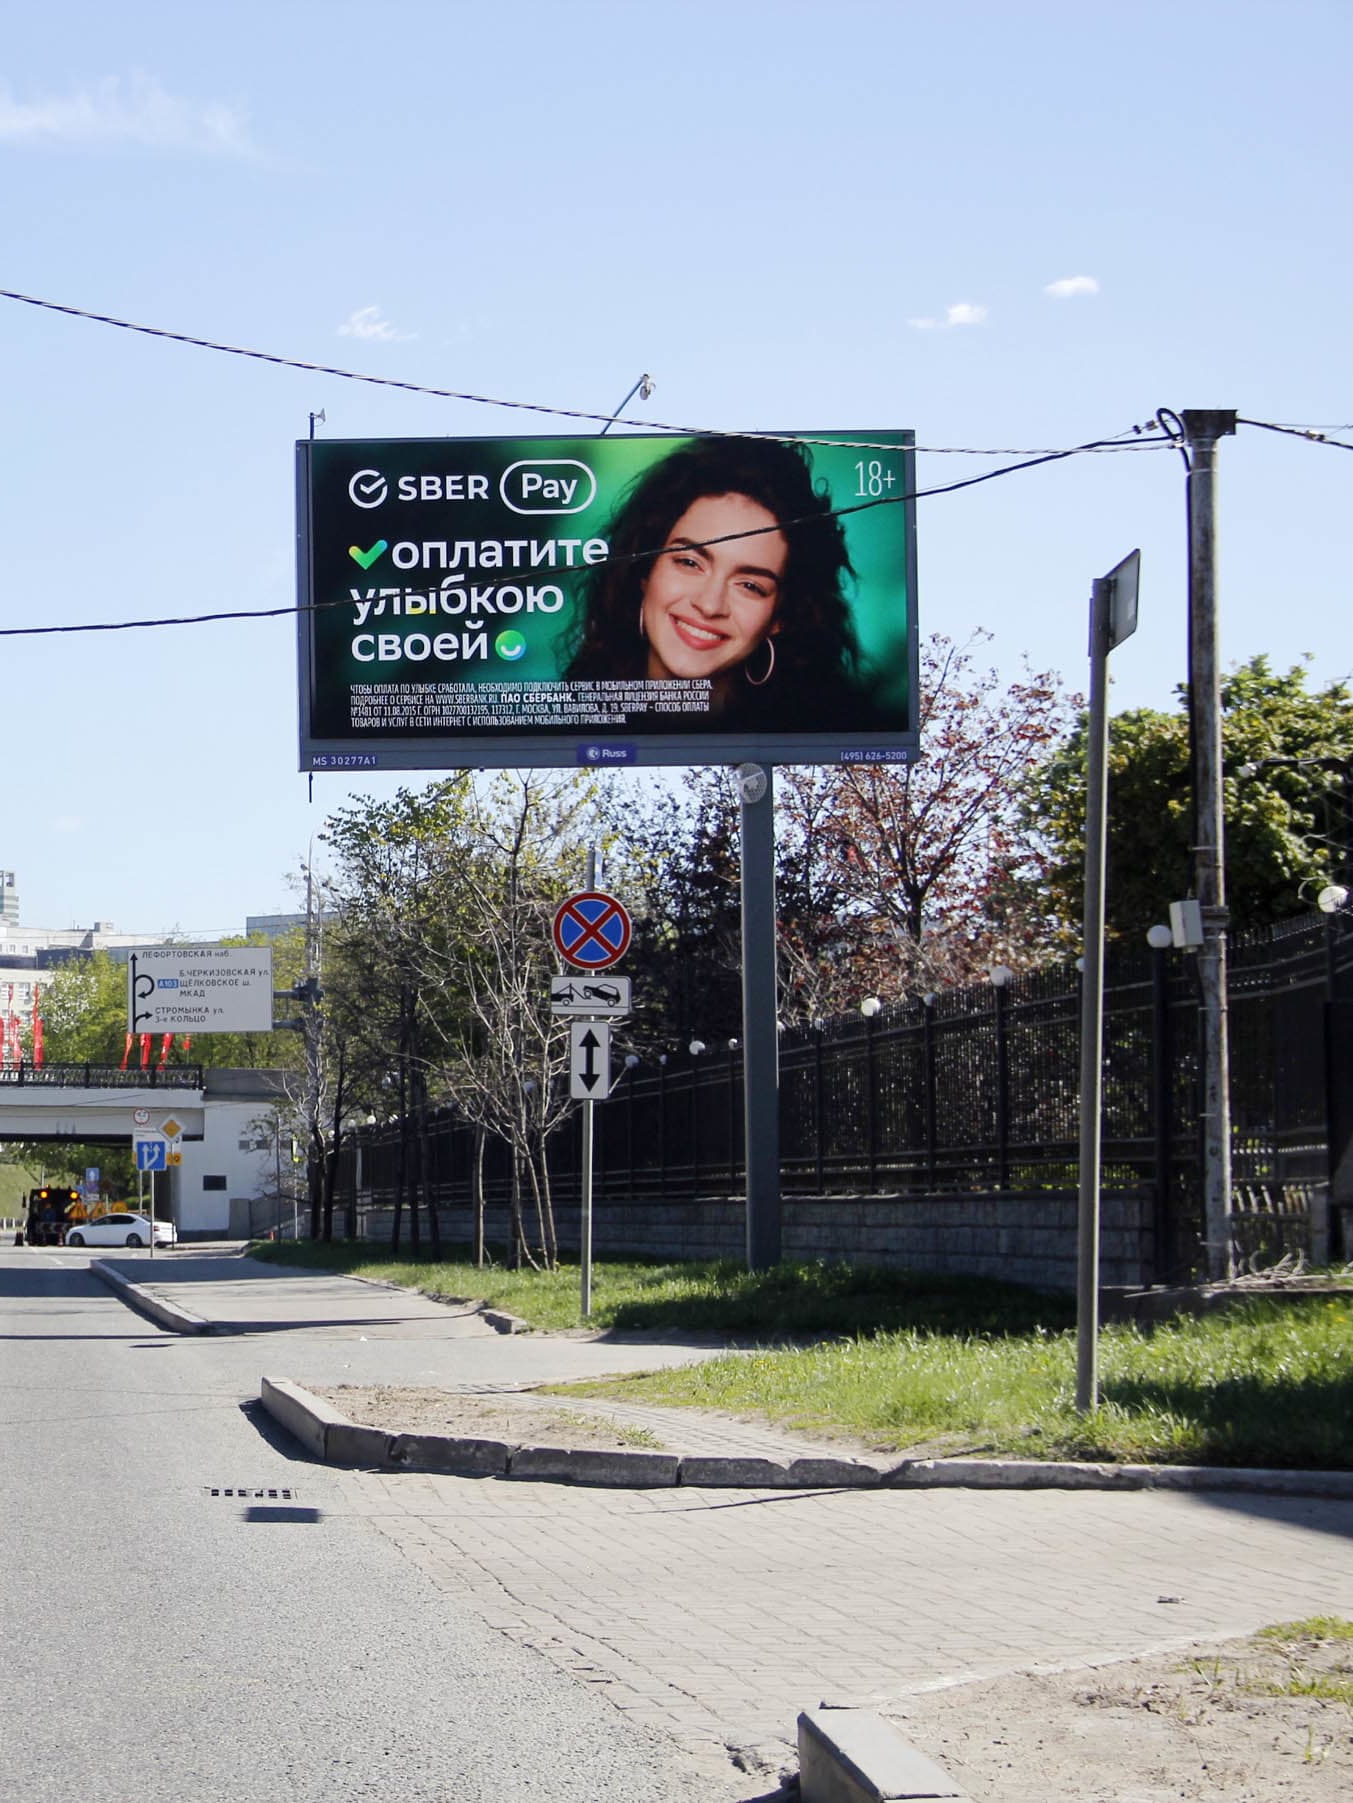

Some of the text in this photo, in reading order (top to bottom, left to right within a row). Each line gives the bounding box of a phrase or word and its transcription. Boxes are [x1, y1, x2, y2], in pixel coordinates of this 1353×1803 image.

[855, 460, 896, 497] 18+
[398, 472, 578, 505] SBER Pay
[391, 537, 609, 570] оплатите
[350, 573, 564, 626] улыбкою
[351, 620, 488, 662] своей
[350, 684, 372, 694] ЧТОБЫ
[374, 684, 399, 694] ОПЛАТА
[400, 683, 410, 694] ПО
[411, 683, 437, 693] УЛЫБКЕ
[437, 683, 477, 693] СРАБОТАЛА,
[478, 682, 523, 693] НЕОБХОДИМО
[524, 682, 569, 692] ПОДКЛЮЧИТЬ
[570, 681, 595, 692] СЕРВИС
[596, 681, 600, 691] В
[601, 681, 644, 691] МОБИЛЬНОМ
[645, 680, 690, 691] ПРИЛОЖЕНИИ
[350, 695, 389, 705] ПОДРОБНЕЕ
[389, 695, 395, 705] О
[396, 695, 424, 705] СЕРВИСЕ
[424, 695, 435, 705] НА
[500, 694, 521, 704] ПАО
[523, 693, 576, 703] СБЕРБАНК.
[577, 693, 623, 703] ГЕНЕРАЛЬНАЯ
[624, 692, 659, 702] ЛИЦЕНЗИЯ
[659, 692, 682, 702] БАНКА
[683, 692, 710, 702] РОССИИ
[373, 706, 382, 716] ОТ
[383, 705, 417, 715] 11.08.2015
[423, 705, 441, 715] ОГРН
[620, 703, 648, 713] SBERPAY
[654, 702, 681, 712] СПОСОБ
[681, 702, 710, 712] ОПЛАТЫ
[351, 717, 381, 727] ТОВАРОВ
[381, 717, 387, 727] И
[387, 716, 408, 726] УСЛУГ
[409, 716, 414, 726] В
[415, 716, 432, 726] СЕТИ
[432, 716, 466, 726] ИНТЕРНЕТ
[466, 716, 472, 726] С
[472, 715, 533, 725] ИСПОЛЬЗОВАНИЕМ
[534, 715, 579, 725] МОБИЛЬНОГО
[601, 748, 627, 758] Russ
[840, 751, 908, 761] (495) 626-5200
[312, 756, 376, 766] MS 30277A1
[142, 950, 212, 959] ЛЕФОРТОВСКАЯ
[179, 968, 257, 977] Б.ЧЕРКИЗОВСКАЯ
[179, 989, 206, 998] МКАД
[154, 1006, 210, 1015] СТРОМЫНКА
[170, 1014, 207, 1023] КОЛЬЦО
